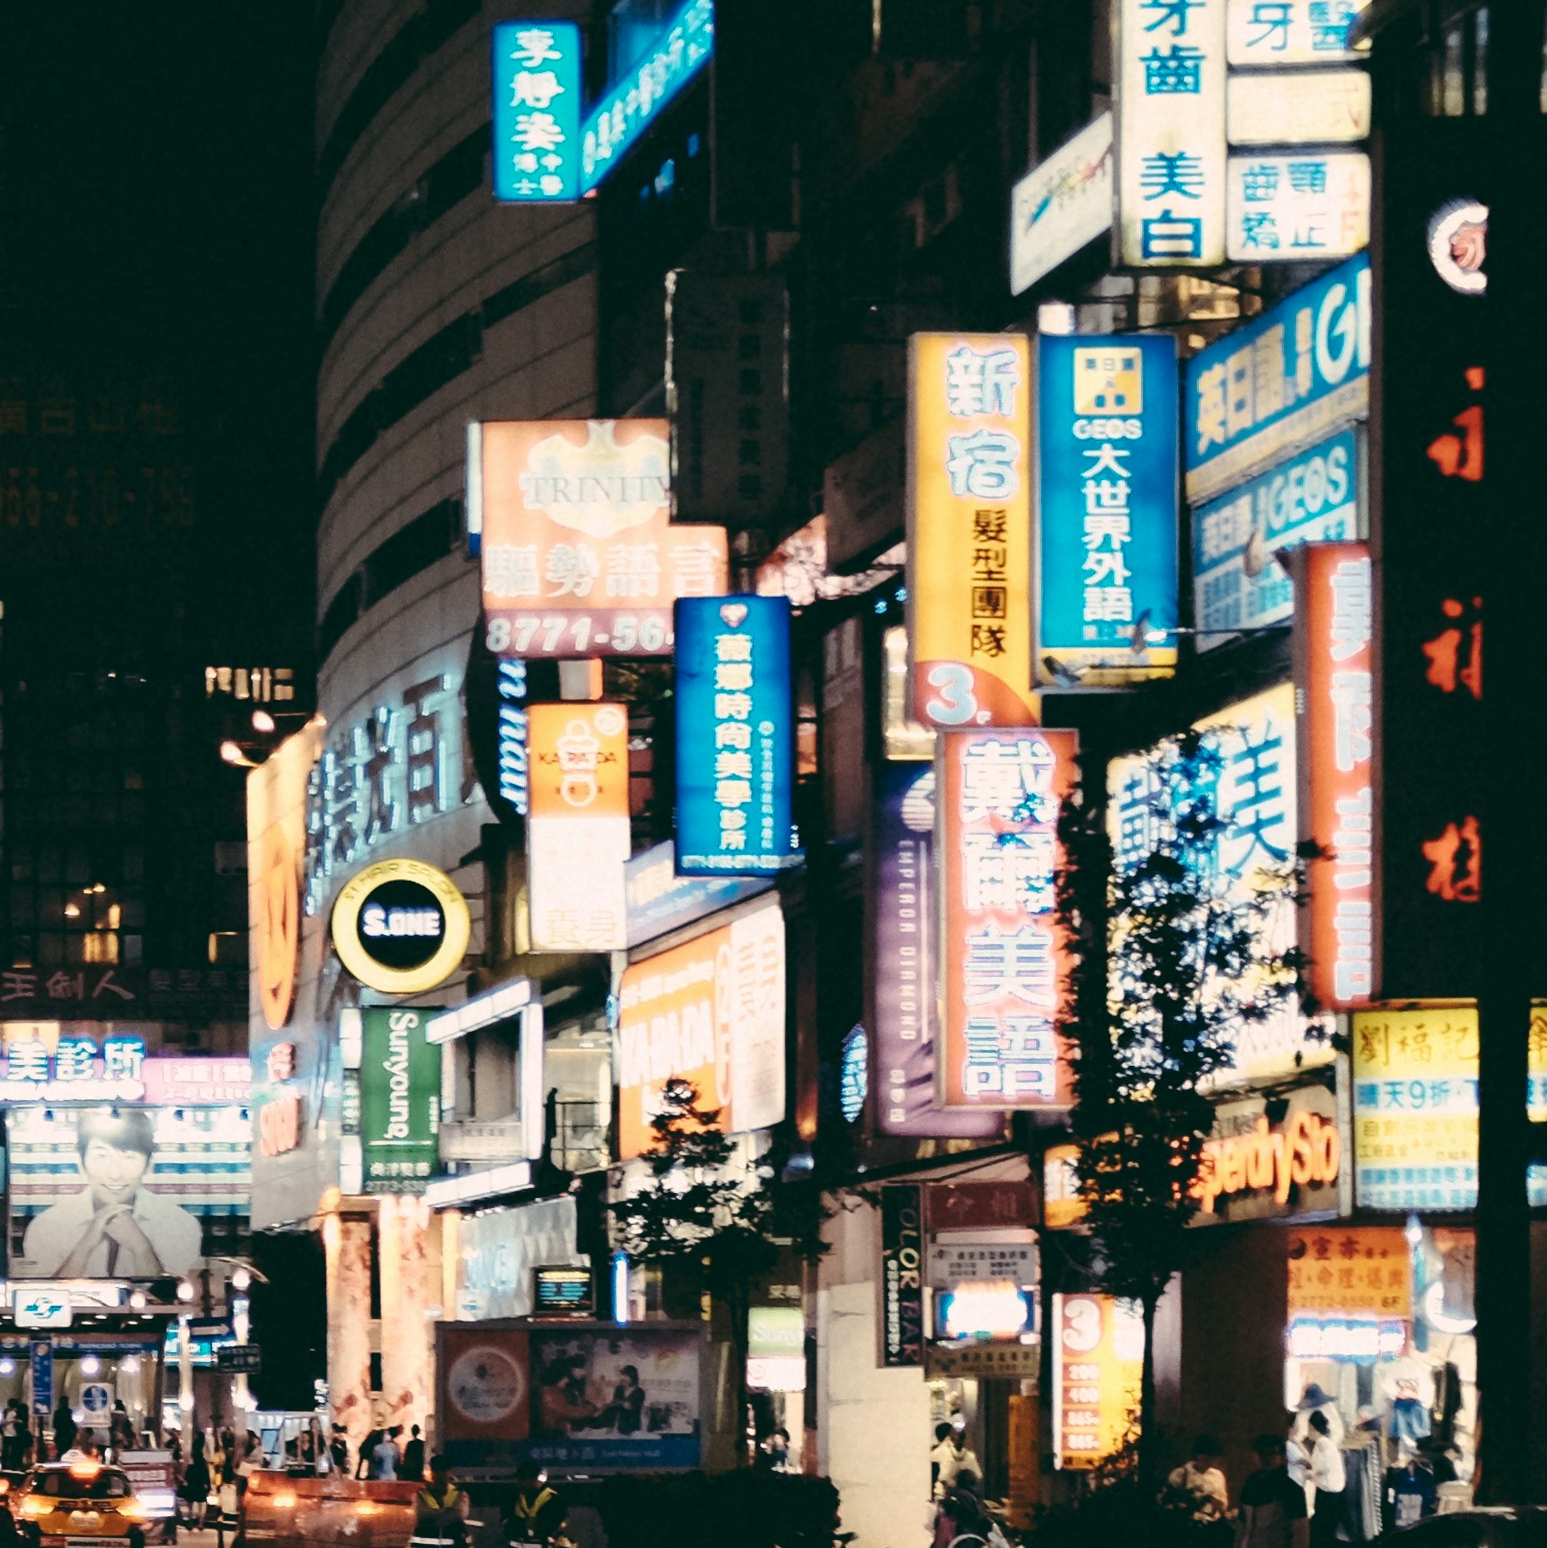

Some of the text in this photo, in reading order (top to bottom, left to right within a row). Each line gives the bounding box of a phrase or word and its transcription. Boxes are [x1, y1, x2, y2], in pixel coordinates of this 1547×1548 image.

[1139, 0, 1206, 95] 牙齒
[1246, 1, 1362, 50] 牙醫
[1140, 152, 1206, 260] 美白
[947, 347, 1019, 499] 新宿
[1073, 419, 1142, 439] GEOS
[524, 475, 672, 503] TRINITY
[1081, 443, 1133, 622] 大世界外語
[1268, 446, 1347, 531] GEOS
[971, 509, 1008, 658] 髮型團隊
[485, 616, 674, 652] 8771-56
[962, 738, 1057, 1098] 戴爾美語
[382, 1011, 419, 1139] Sunyoung
[899, 1301, 920, 1361] BAR
